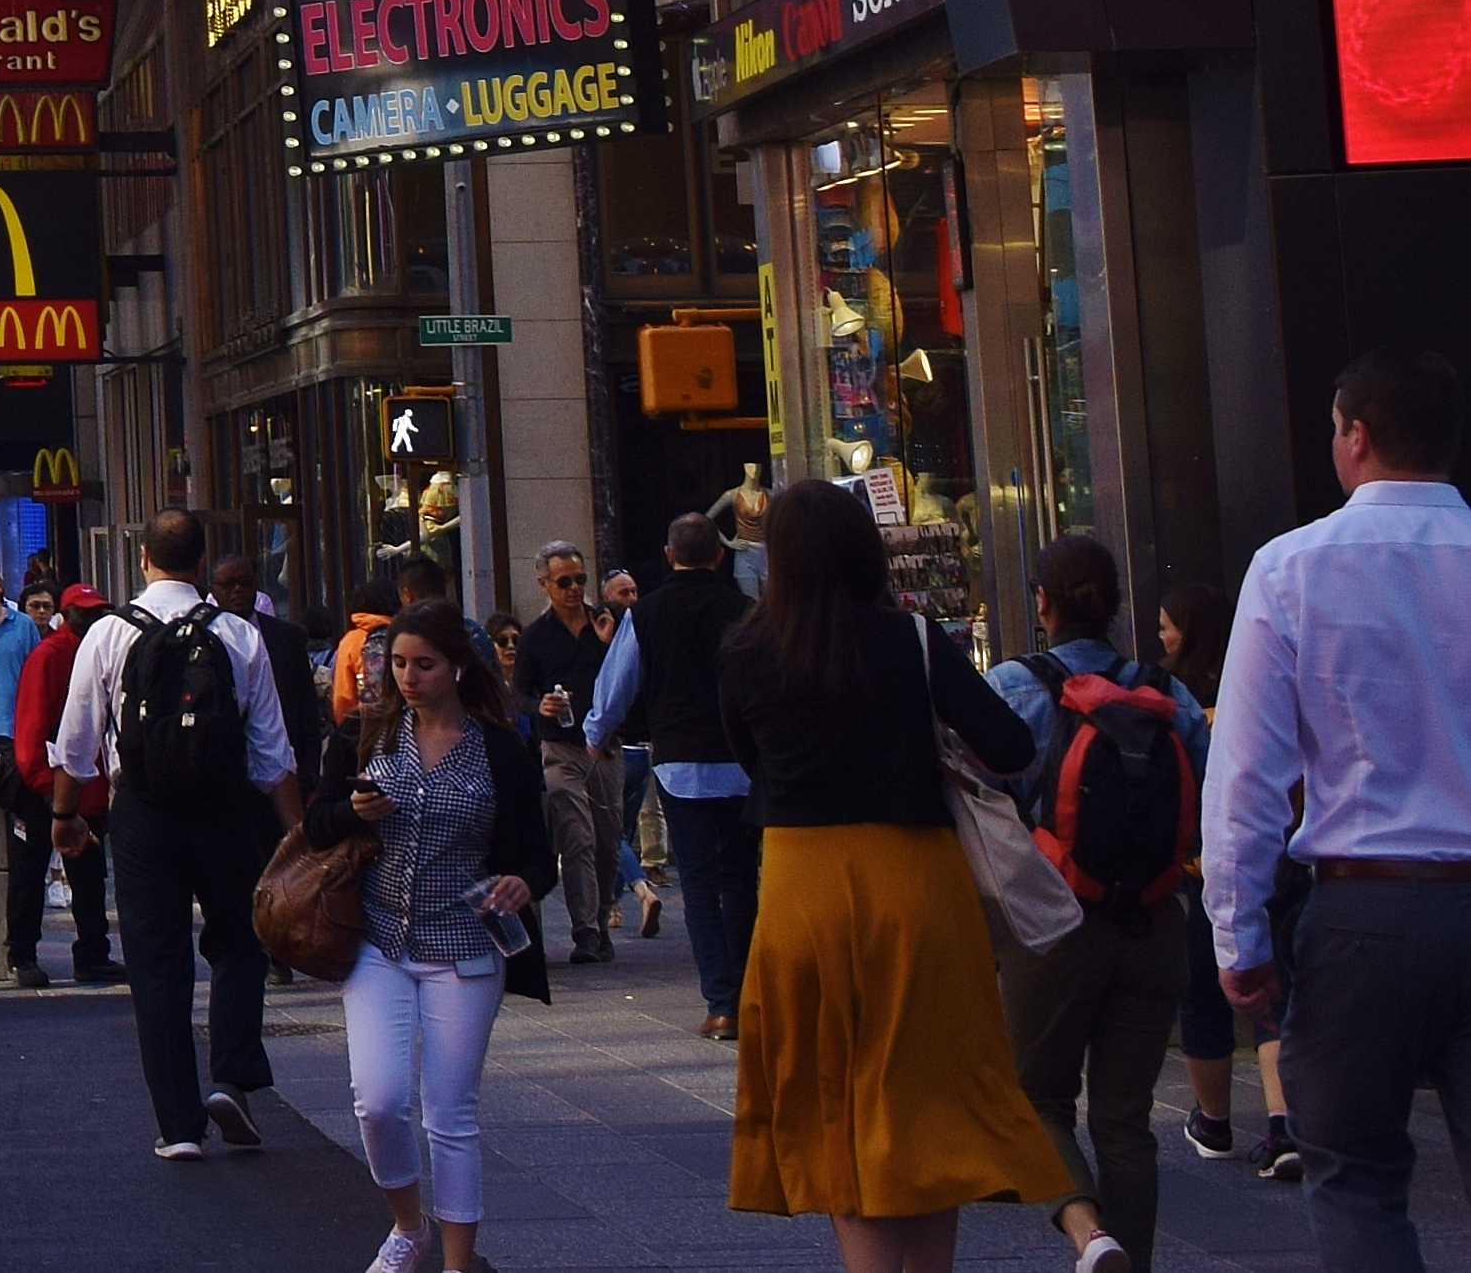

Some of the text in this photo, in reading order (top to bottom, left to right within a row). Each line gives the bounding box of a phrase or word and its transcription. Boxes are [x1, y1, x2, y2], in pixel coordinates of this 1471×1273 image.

[734, 19, 777, 83] Nikon
[310, 88, 446, 147] CAMERA
[459, 60, 621, 127] LUGGAGE
[425, 318, 506, 336] LITTLE BRAZIL
